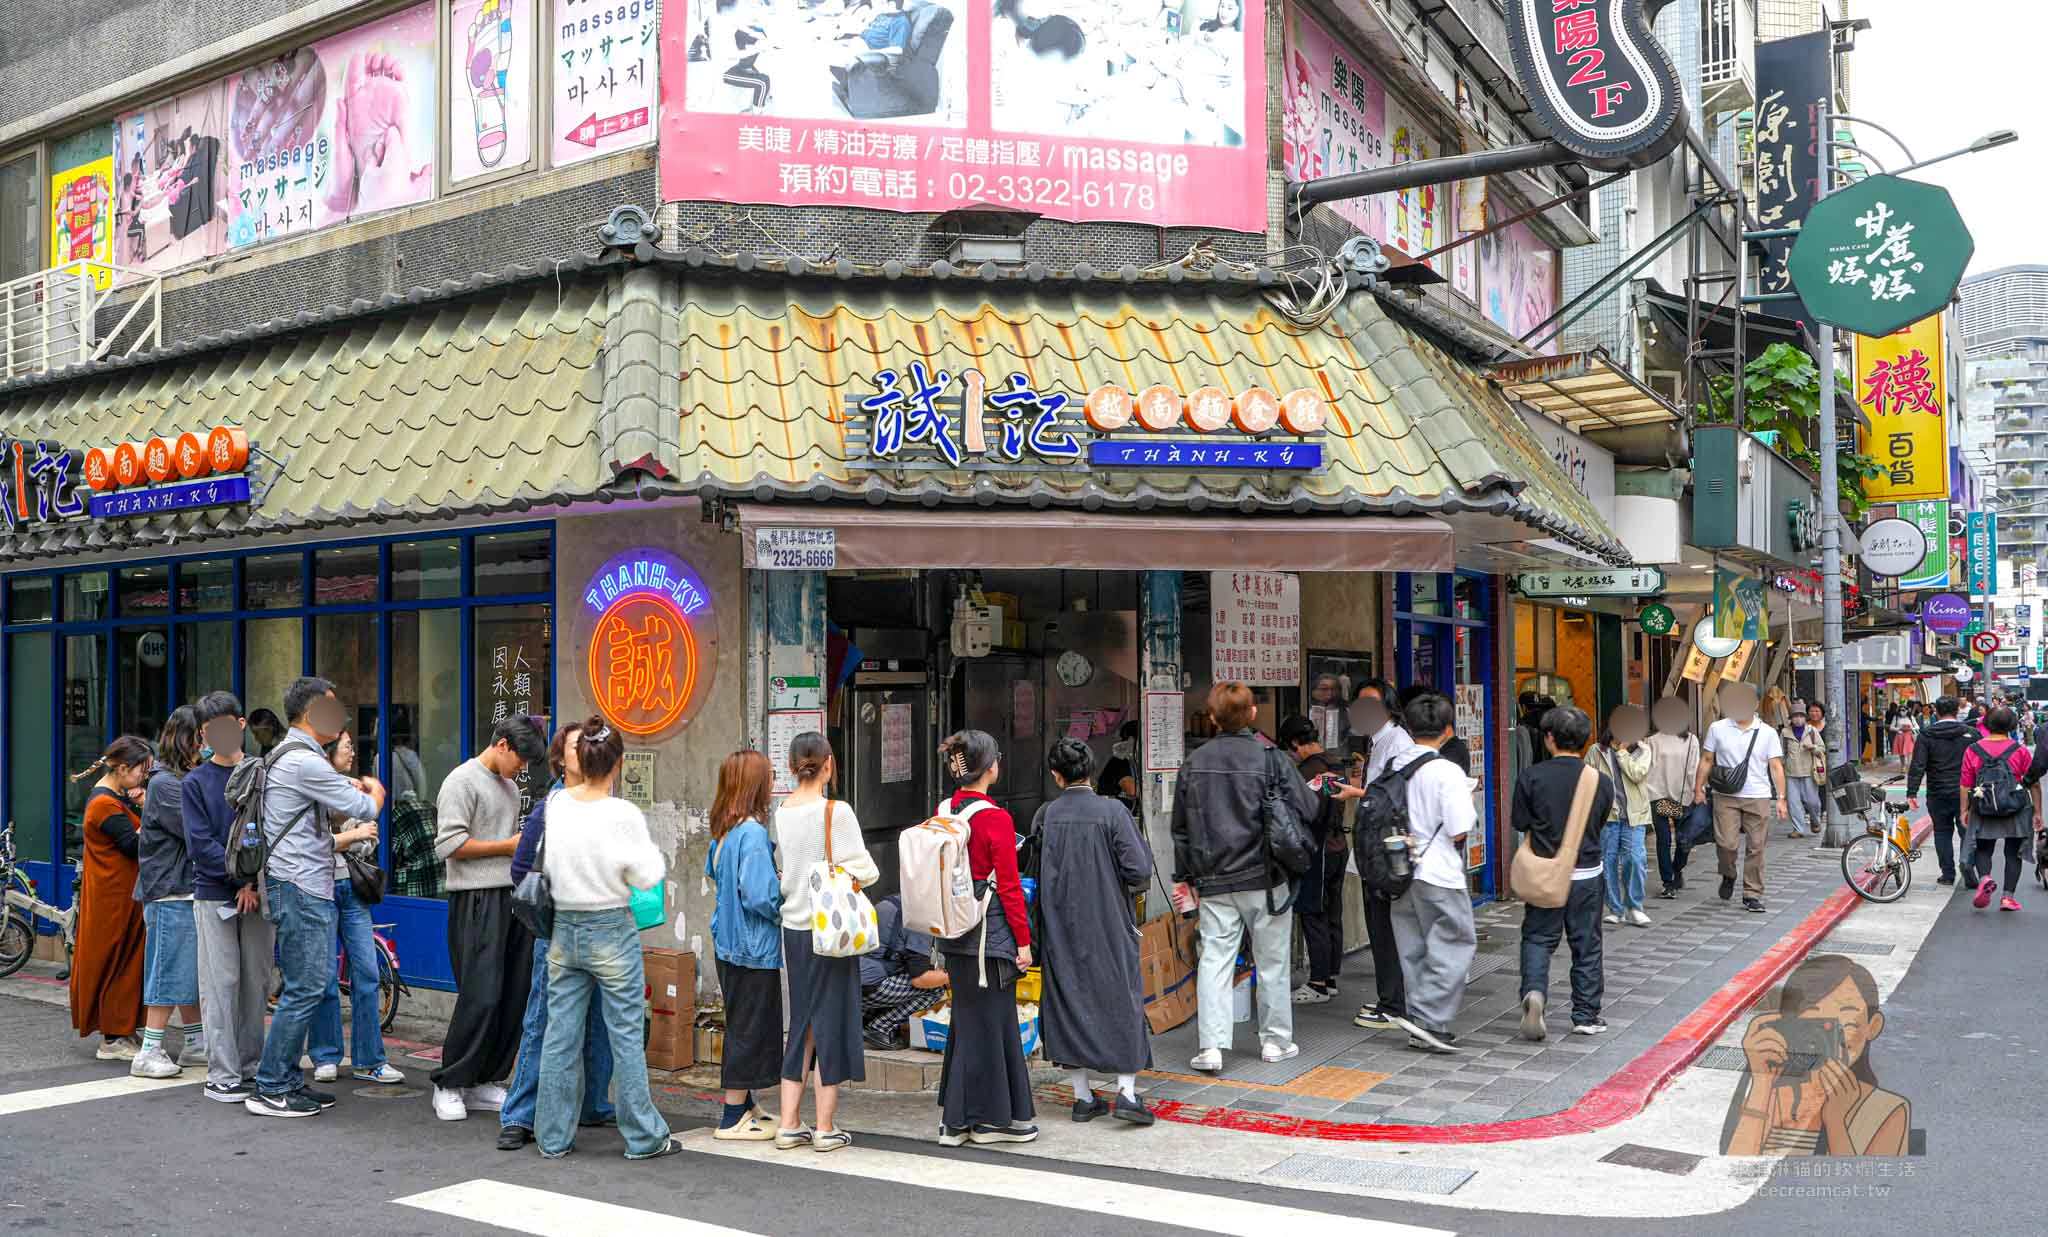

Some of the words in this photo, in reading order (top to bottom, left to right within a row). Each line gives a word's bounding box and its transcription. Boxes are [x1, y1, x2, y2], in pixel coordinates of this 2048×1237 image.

[561, 0, 655, 40] massage
[561, 20, 655, 68] マッサージ
[567, 57, 644, 105] 마사지
[1333, 55, 1366, 115] 樂陽
[1321, 90, 1382, 158] massage
[240, 138, 329, 180] massage
[738, 125, 792, 153] 美睫
[813, 127, 919, 161] 精油芳療
[939, 136, 1041, 167] 足體指壓
[1063, 145, 1189, 182] massage
[239, 161, 328, 209] マッサージ
[948, 171, 1157, 211] 02-3322-6178
[254, 199, 315, 236] 마사지
[1862, 348, 1942, 417] 襪
[88, 435, 230, 483] 越南麵食館
[1888, 431, 1915, 488] 百貨
[773, 549, 834, 567] 2325-6666
[586, 560, 704, 615] THANH-KY
[1928, 600, 1967, 615] Kimo
[607, 615, 675, 711] 誠
